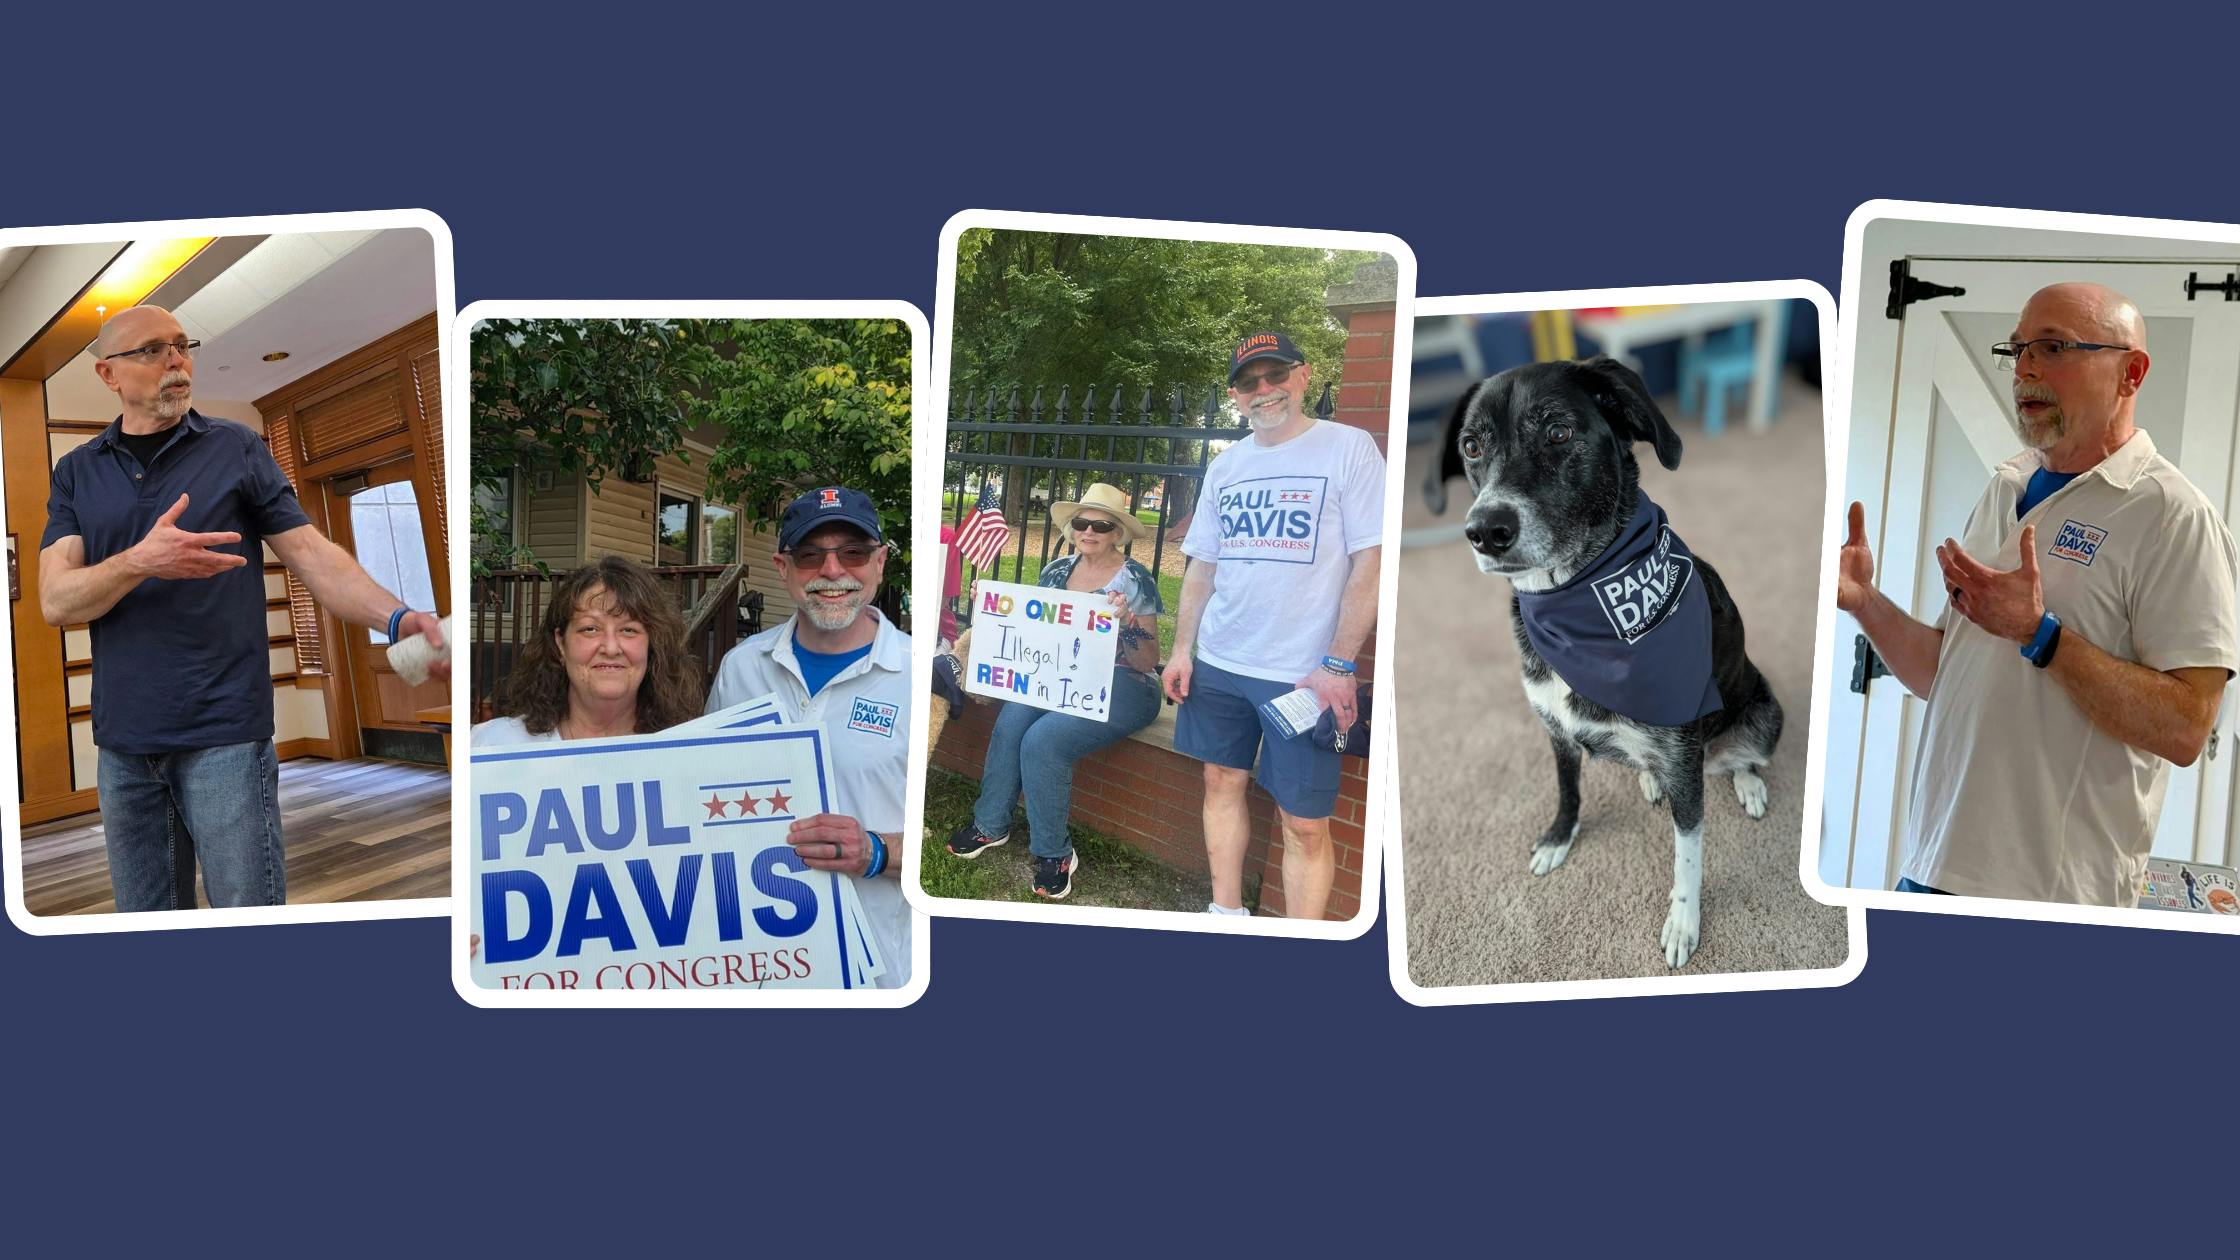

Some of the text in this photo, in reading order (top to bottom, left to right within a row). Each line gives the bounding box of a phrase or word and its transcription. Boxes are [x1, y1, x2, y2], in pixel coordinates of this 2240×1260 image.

[1236, 334, 1278, 358] ILLINOIS
[1220, 489, 1274, 513] PAUL
[1219, 510, 1312, 539] DAVIS
[2063, 525, 2086, 540] PAUL
[1249, 539, 1310, 550] CONGRESS
[2057, 535, 2096, 555] DAVIS
[1604, 554, 1662, 607] PAUL
[1613, 560, 1670, 631] DAV
[983, 591, 1014, 614] NO
[1025, 599, 1073, 625] ONE
[1625, 622, 1647, 638] FOR
[1037, 681, 1049, 701] in
[853, 711, 892, 728] DAVIS
[856, 702, 880, 714] PAUL
[479, 779, 691, 861] PAUL
[2200, 874, 2235, 890] LIFE IS
[480, 845, 819, 964] DAVIS
[595, 947, 812, 989] CONGRESS
